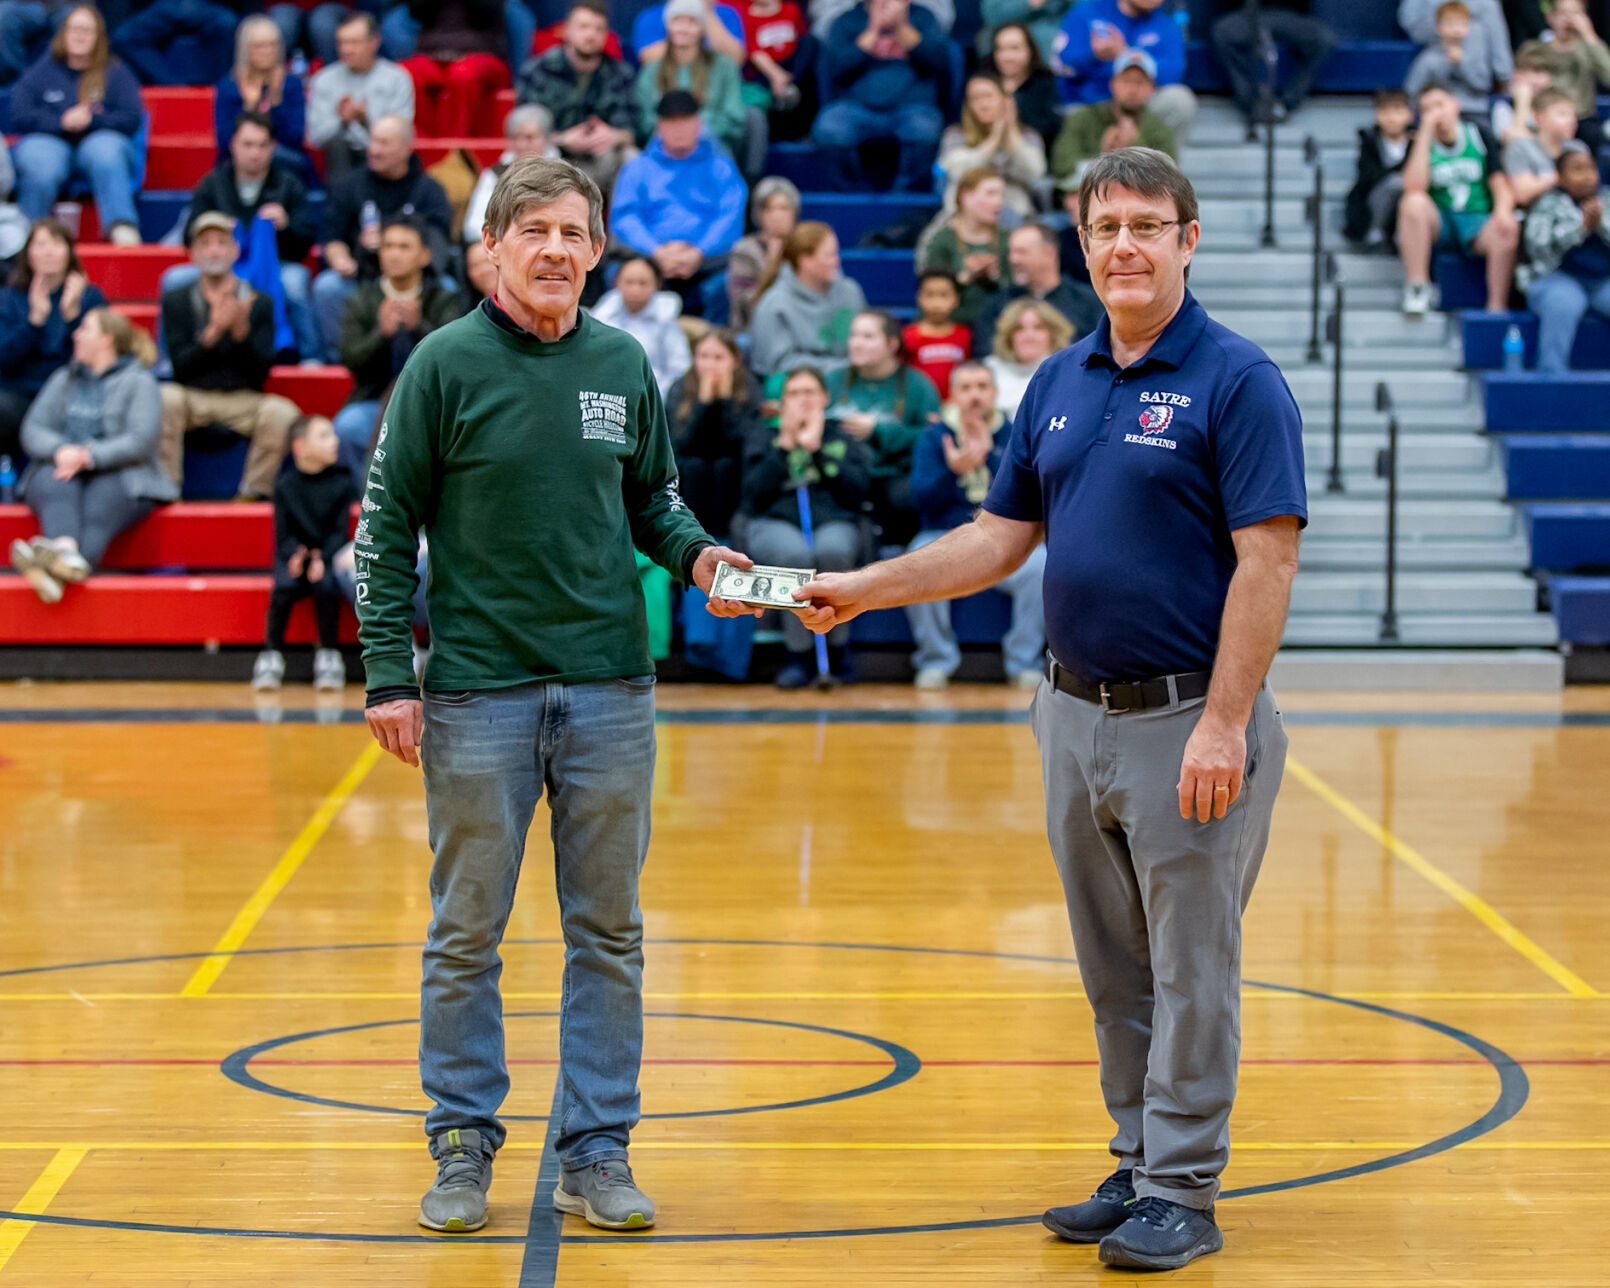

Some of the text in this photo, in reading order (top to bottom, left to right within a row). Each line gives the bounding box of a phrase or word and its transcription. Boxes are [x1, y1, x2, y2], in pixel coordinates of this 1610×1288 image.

[591, 400, 626, 416] WASHINGTON
[599, 392, 627, 407] ANNUAL
[1139, 391, 1192, 408] SAYRE
[581, 408, 627, 426] AUTO ROAD
[1123, 433, 1177, 450] REDSKINS
